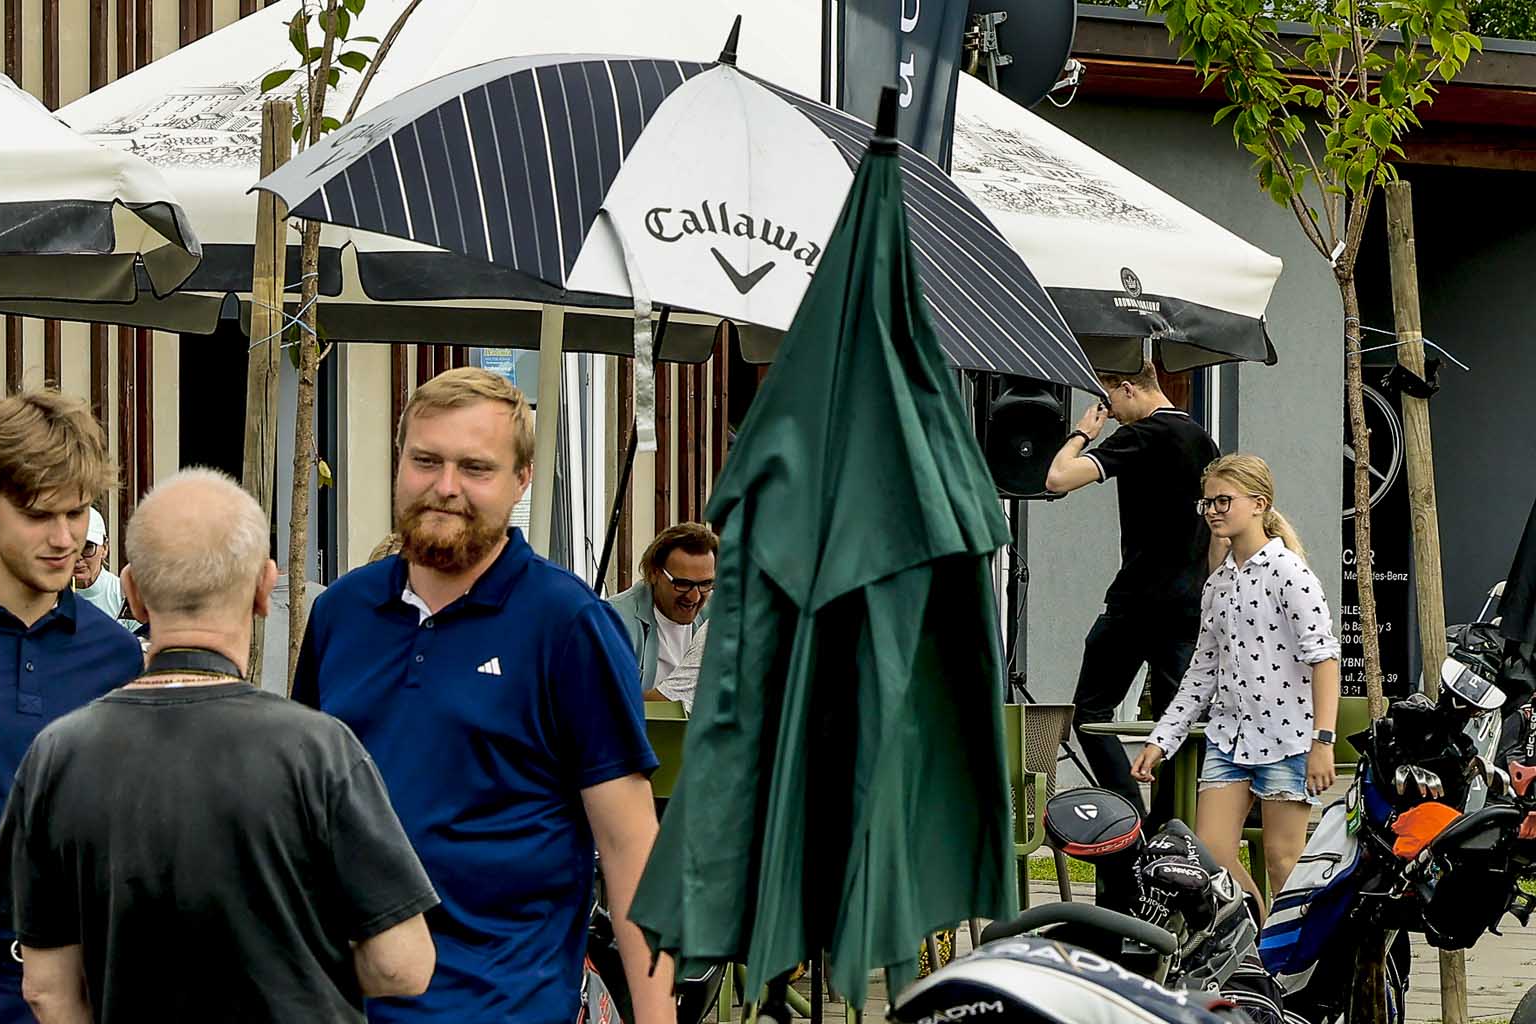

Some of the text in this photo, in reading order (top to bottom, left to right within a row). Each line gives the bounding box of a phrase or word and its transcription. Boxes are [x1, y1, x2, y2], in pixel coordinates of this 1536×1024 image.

[644, 199, 822, 279] Callawa
[1344, 672, 1356, 682] ul.
[1386, 673, 1398, 683] 39
[1138, 896, 1170, 918] Solaire
